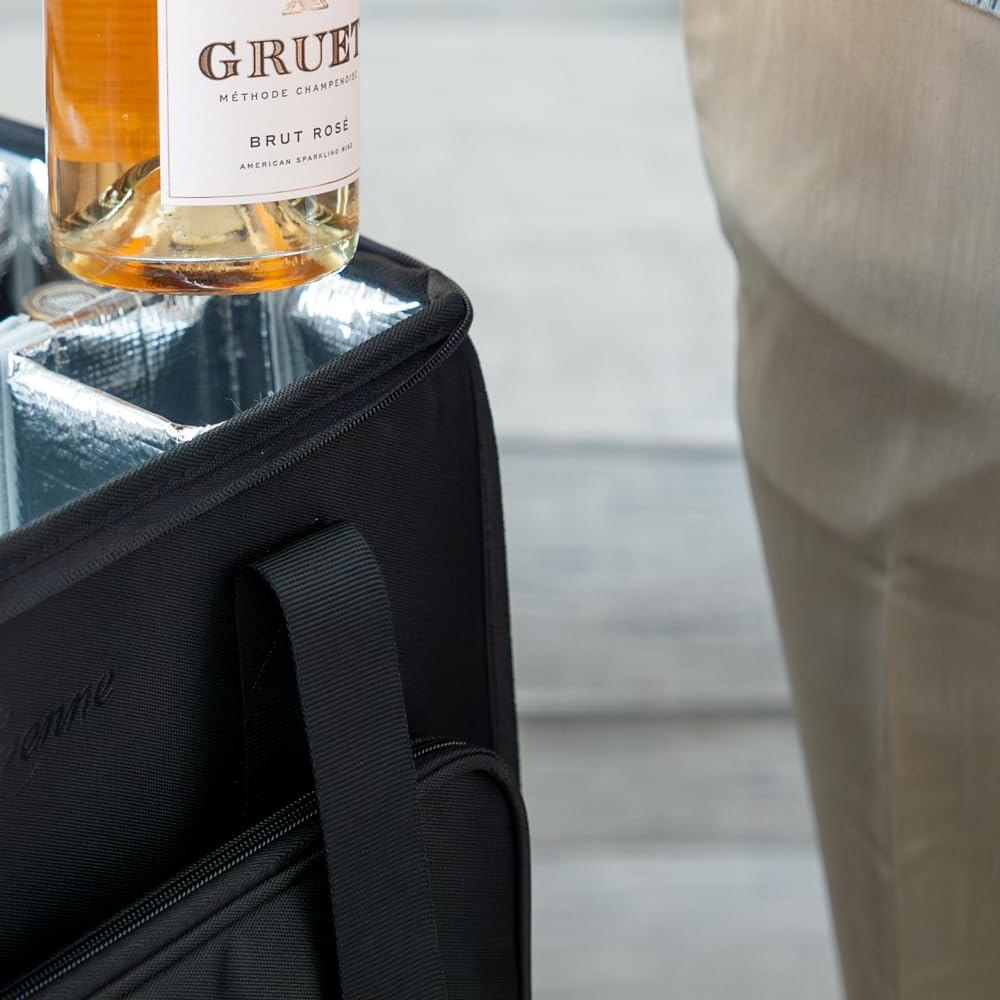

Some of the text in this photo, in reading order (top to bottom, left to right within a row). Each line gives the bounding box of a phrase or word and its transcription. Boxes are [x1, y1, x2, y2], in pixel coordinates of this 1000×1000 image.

[198, 18, 360, 80] GRUET
[219, 88, 288, 102] MÉTHODE
[250, 117, 349, 148] BRUT ROSÉ
[239, 158, 292, 170] AMERICAN
[296, 151, 339, 164] SPARKLING
